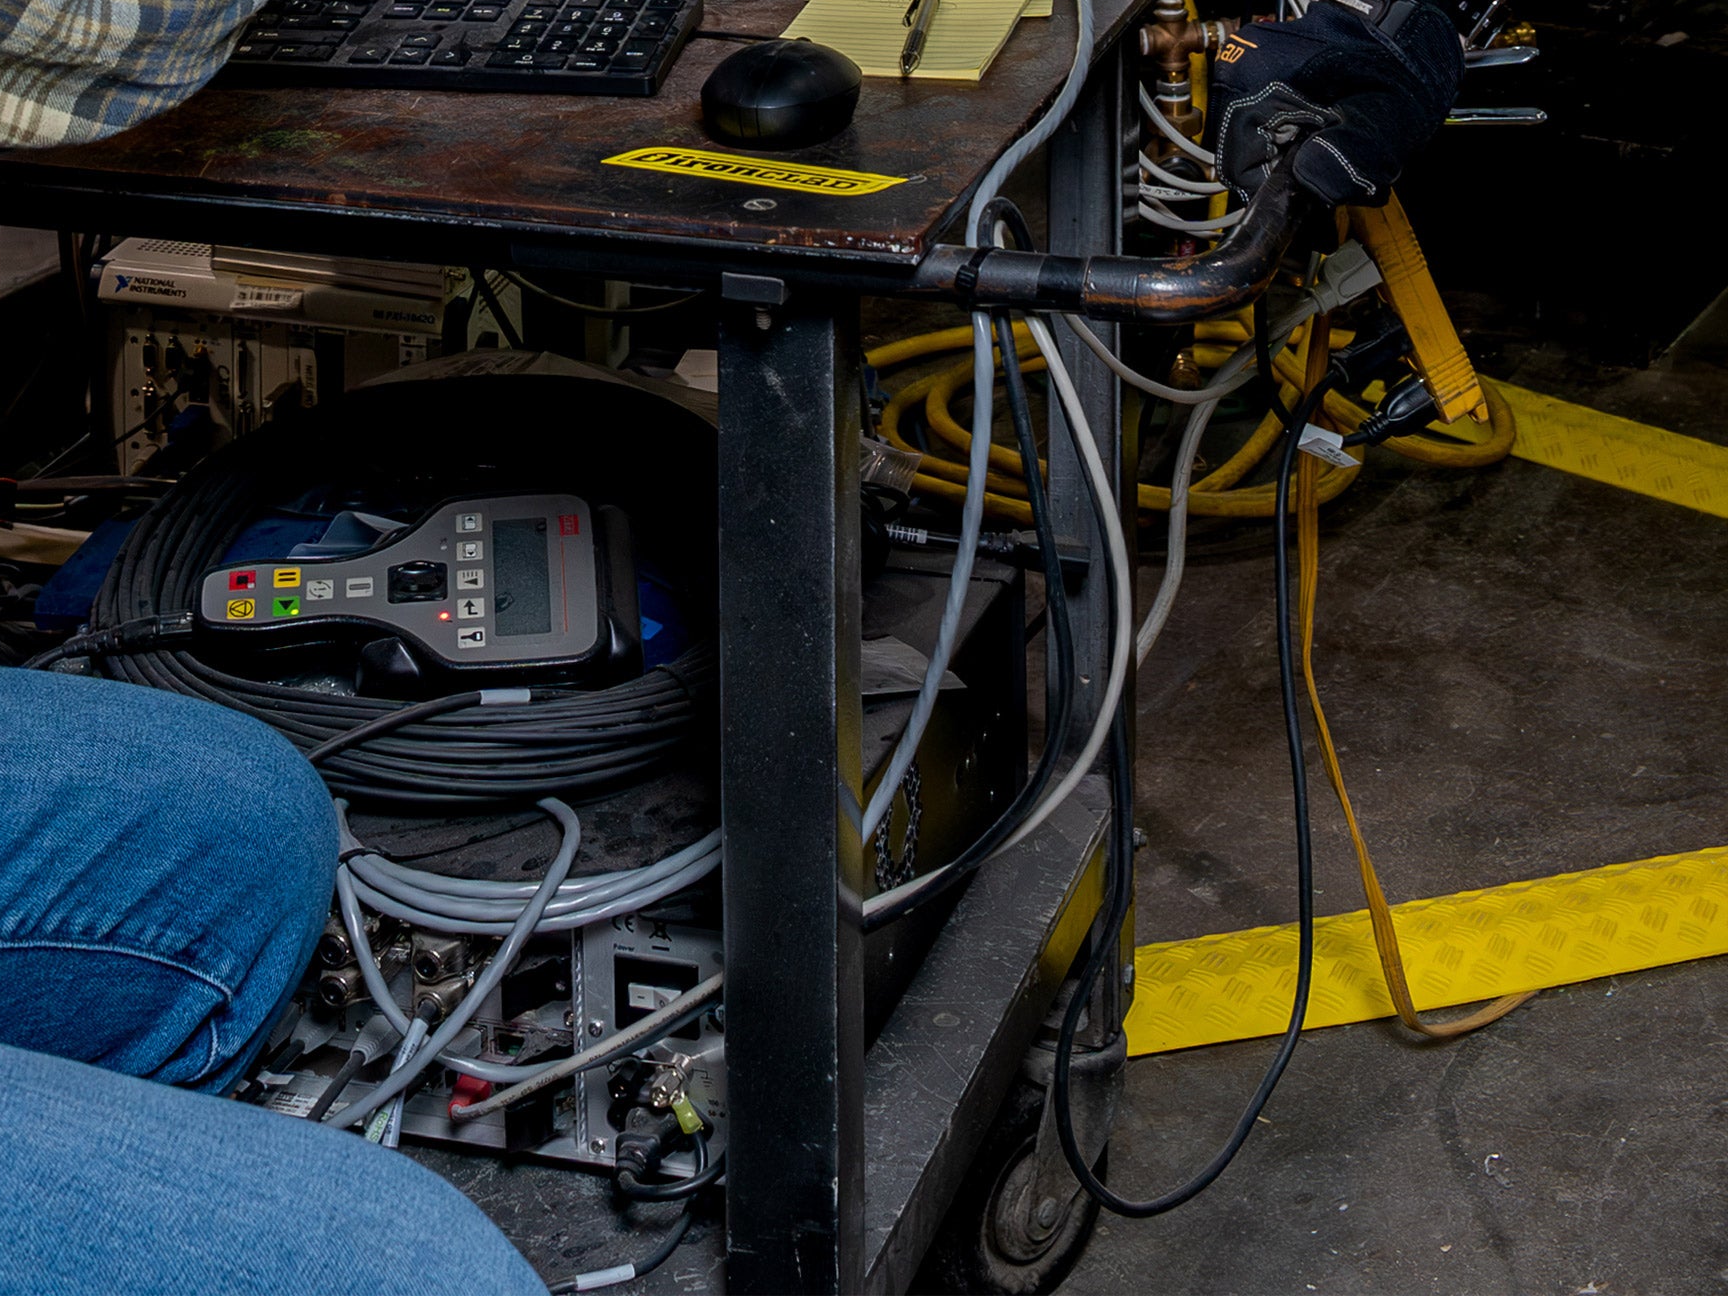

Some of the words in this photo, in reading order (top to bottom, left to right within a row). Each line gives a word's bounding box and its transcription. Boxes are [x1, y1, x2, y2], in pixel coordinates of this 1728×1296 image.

[133, 276, 176, 289] NATIONAL
[129, 286, 187, 299] INSTRUMENTS
[613, 943, 636, 952] Power
[370, 1111, 389, 1142] RoHS
